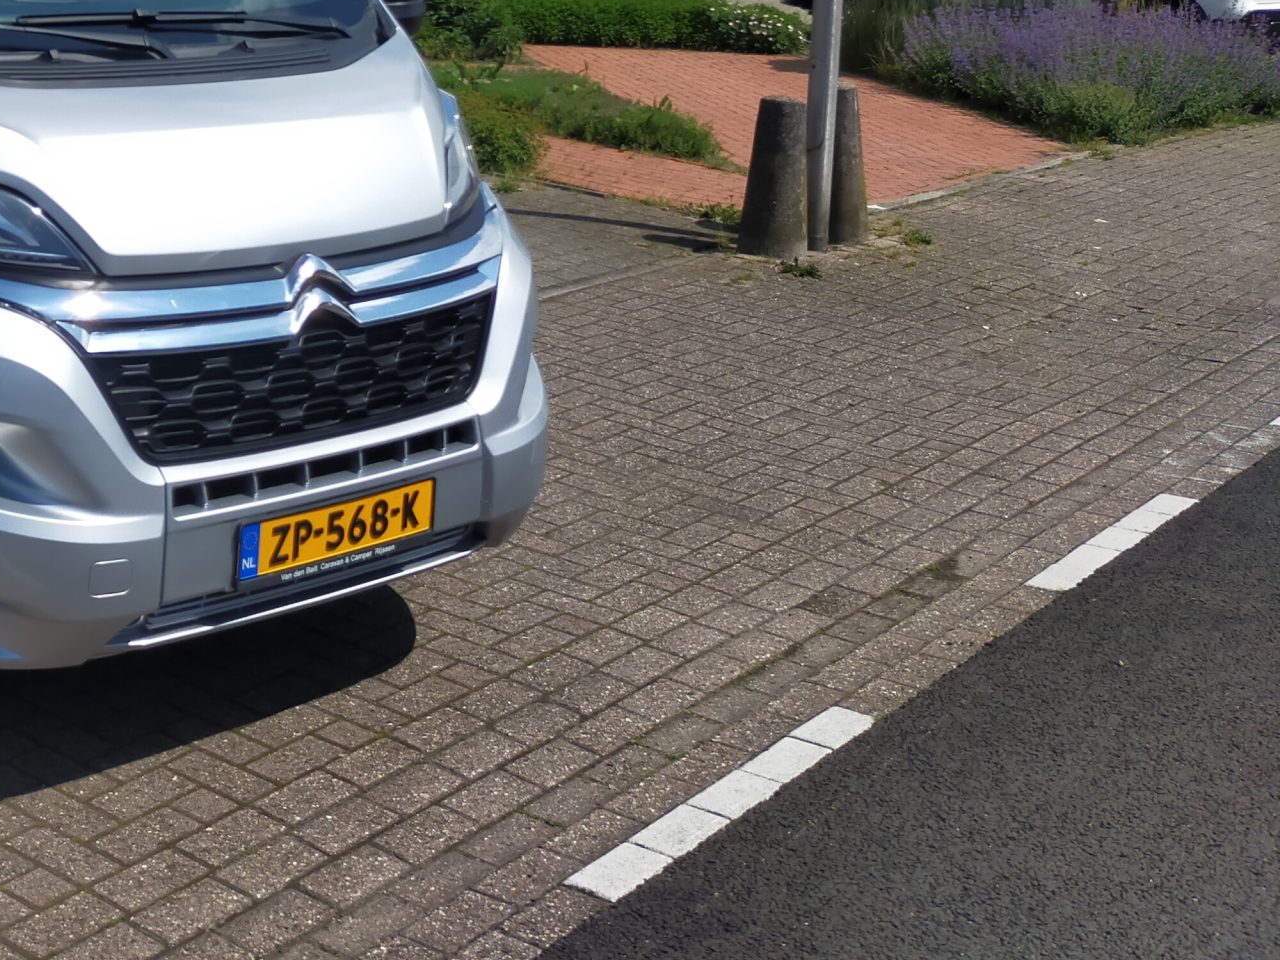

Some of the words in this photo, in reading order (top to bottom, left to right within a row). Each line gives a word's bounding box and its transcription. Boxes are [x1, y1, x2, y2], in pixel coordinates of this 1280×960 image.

[269, 490, 420, 568] ZP-568-K
[241, 558, 256, 570] NL
[280, 572, 293, 581] Van
[293, 568, 305, 578] den
[320, 558, 344, 571] Caravan
[344, 555, 351, 564] &
[350, 550, 373, 562] Camper
